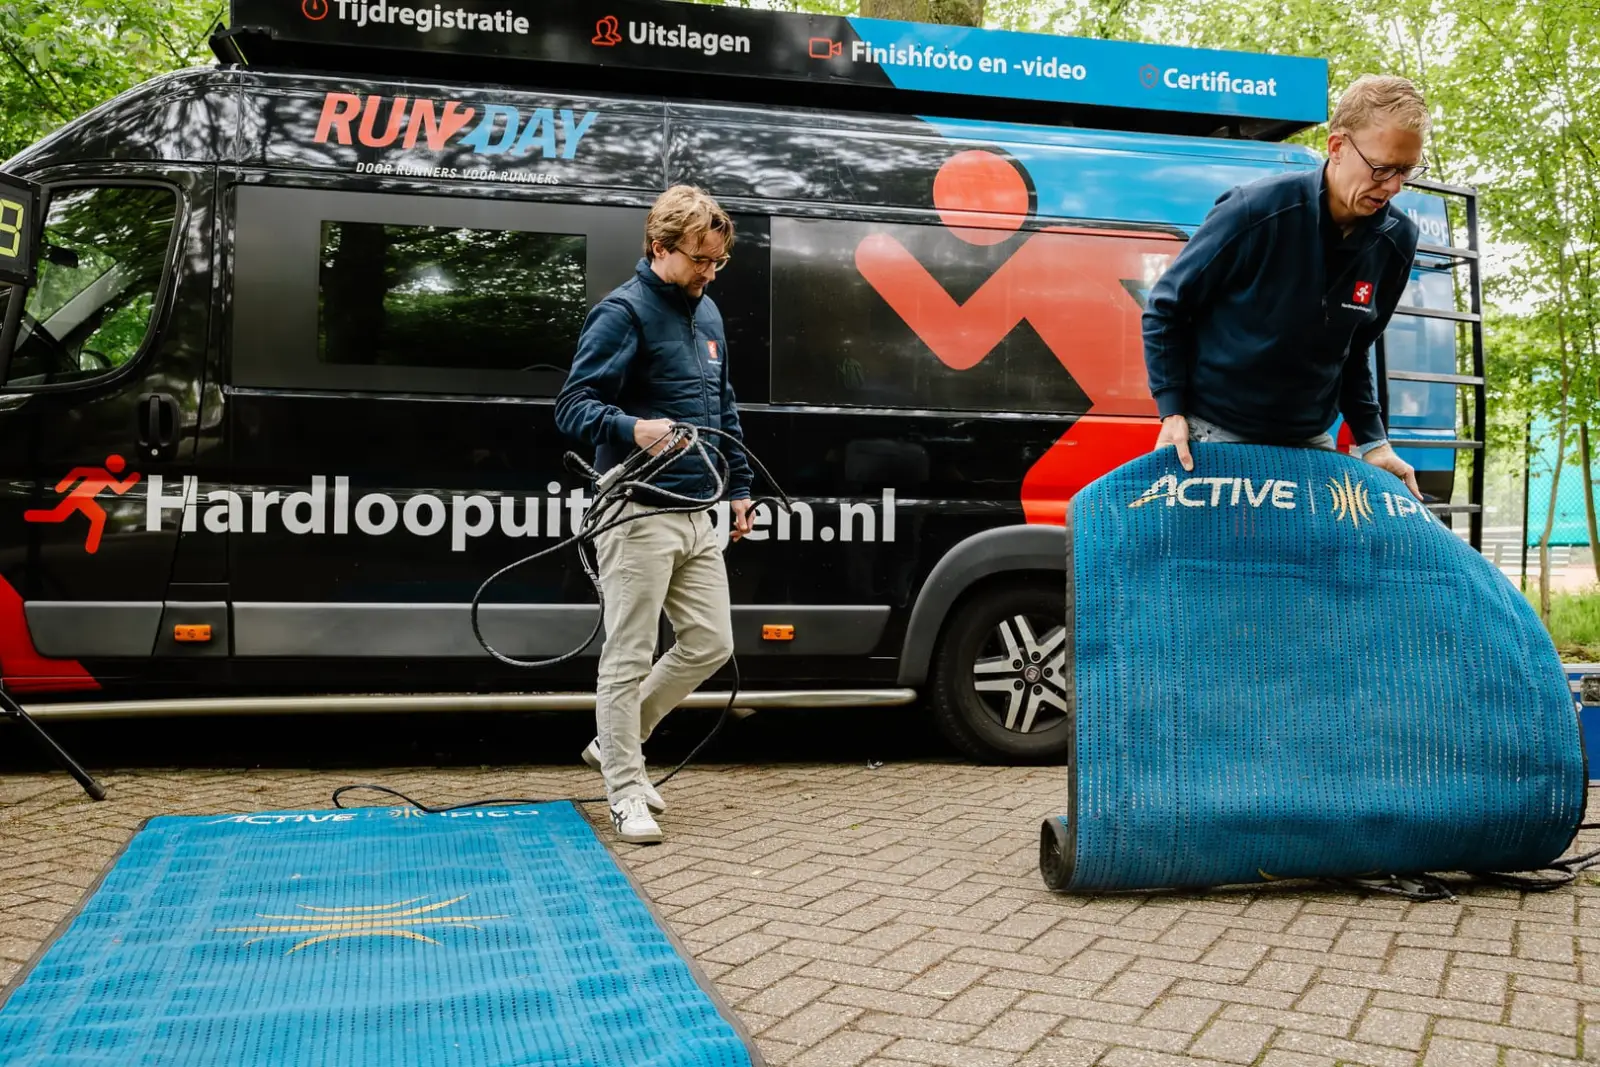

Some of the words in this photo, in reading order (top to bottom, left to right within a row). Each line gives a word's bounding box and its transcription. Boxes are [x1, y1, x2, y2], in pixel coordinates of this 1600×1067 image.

[334, 0, 530, 35] Tijdregistratie
[628, 20, 751, 55] Uitslagen
[851, 40, 972, 72] Finishfoto
[978, 56, 1008, 75] en
[1013, 57, 1087, 82] -video
[1163, 67, 1277, 97] Certificaat
[356, 162, 392, 175] DOOR
[396, 165, 457, 180] RUNNERS
[462, 169, 496, 182] VOOR
[500, 171, 560, 185] RUNNERS
[1128, 475, 1298, 510] ACTIVE
[146, 474, 896, 552] Hardloopuitgen.nl
[206, 813, 358, 825] ACTIVE
